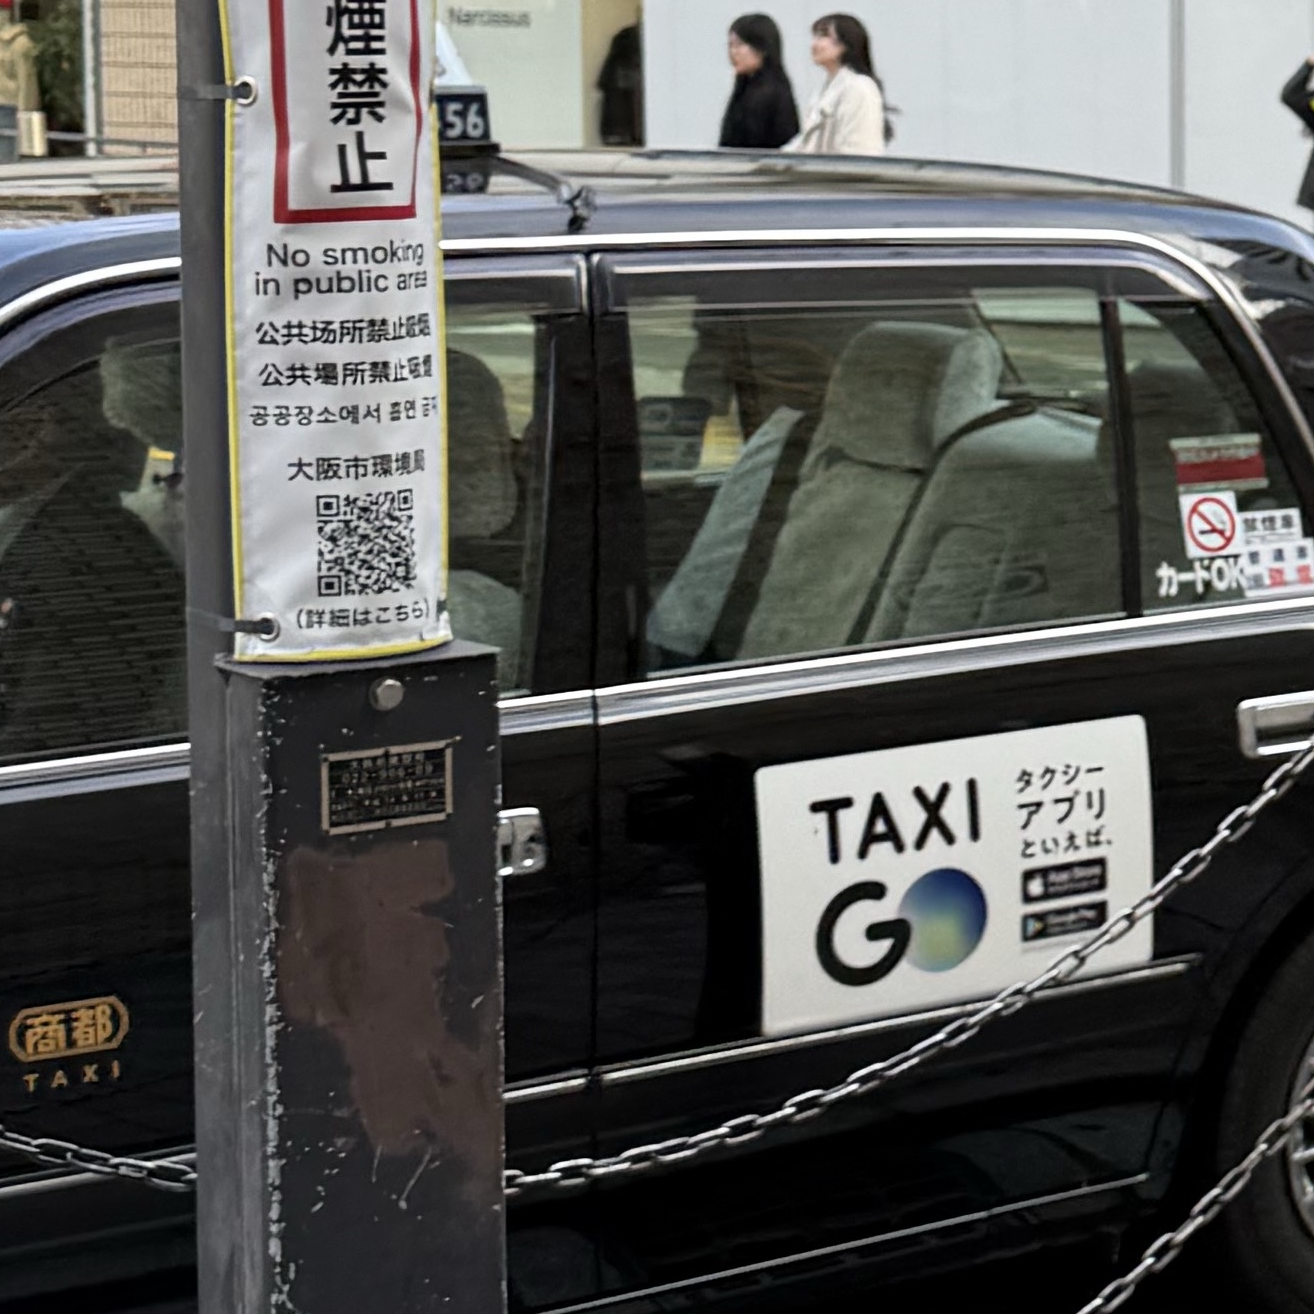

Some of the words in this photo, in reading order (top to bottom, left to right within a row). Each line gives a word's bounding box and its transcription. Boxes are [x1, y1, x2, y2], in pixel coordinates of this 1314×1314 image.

[267, 243, 310, 268] No
[323, 240, 424, 266] smoking
[255, 271, 281, 296] in
[293, 269, 389, 300] public
[250, 403, 382, 427] 공공장소에서
[287, 448, 425, 482] 大阪市環境局
[1155, 557, 1249, 598] カードOK
[297, 598, 430, 629] (詳細はこちら)
[1016, 764, 1104, 794] タクシー
[809, 777, 981, 864] TAXI
[1017, 787, 1105, 830] アプリ
[1020, 825, 1113, 859] といえば、
[816, 867, 988, 987] GO
[25, 1004, 113, 1055] 商都
[22, 1059, 120, 1093] TAXI
